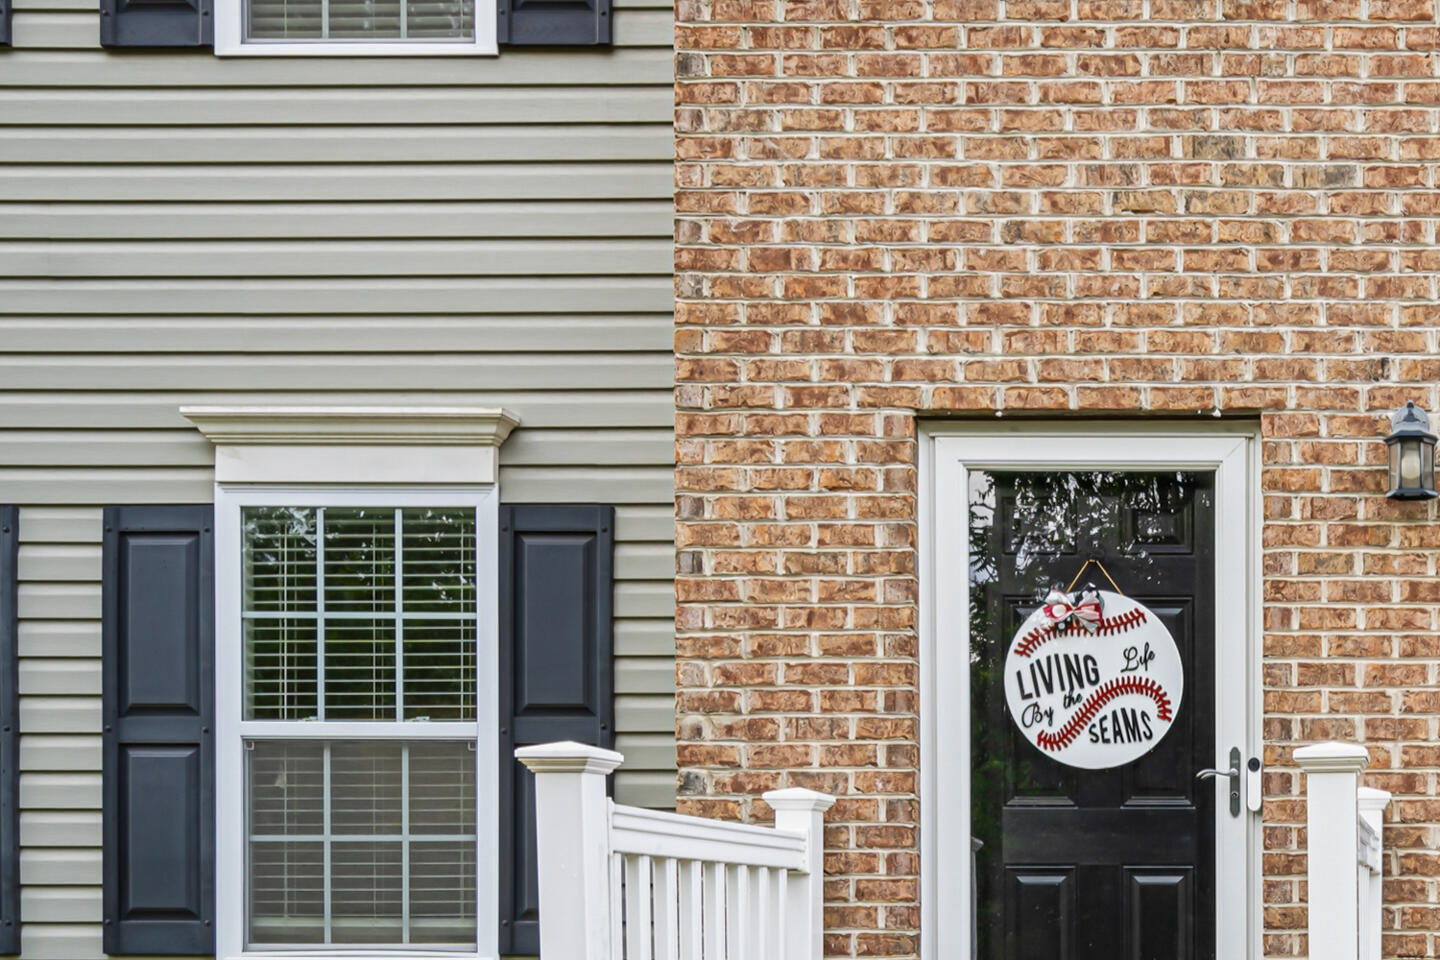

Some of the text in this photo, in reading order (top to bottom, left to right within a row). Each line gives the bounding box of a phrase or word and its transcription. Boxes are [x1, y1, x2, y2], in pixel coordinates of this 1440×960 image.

[1016, 642, 1155, 700] LIVING Life
[1021, 687, 1083, 729] By the
[1088, 707, 1153, 744] SEAMS
